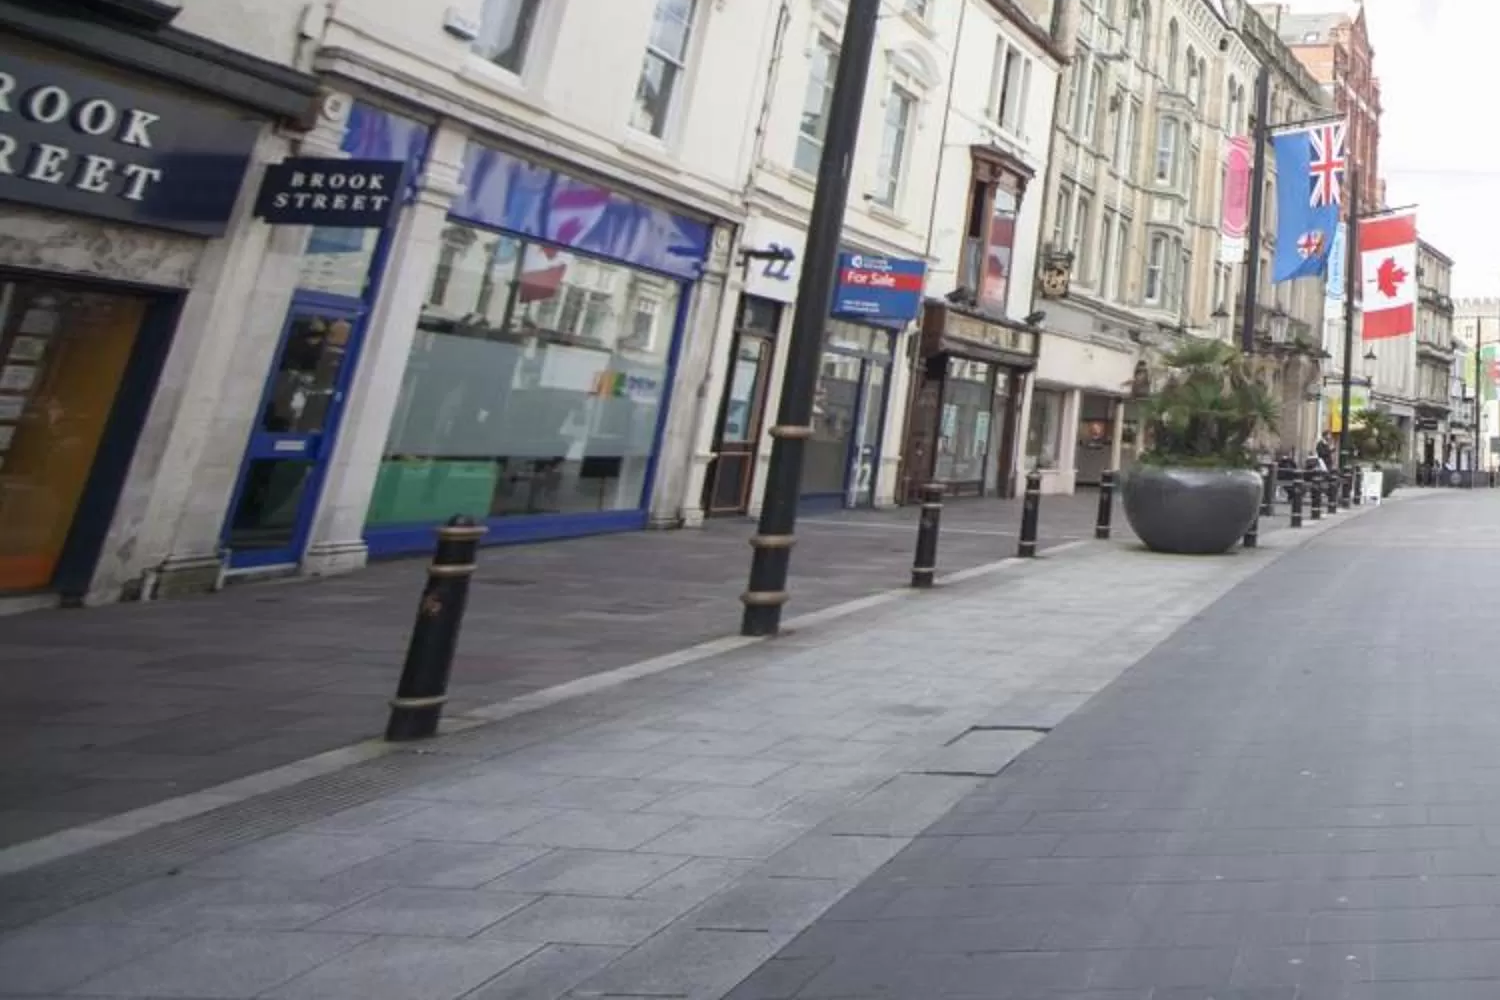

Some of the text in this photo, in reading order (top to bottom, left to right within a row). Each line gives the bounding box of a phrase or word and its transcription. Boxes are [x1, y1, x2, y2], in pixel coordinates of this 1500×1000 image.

[290, 171, 386, 189] BROOK
[272, 193, 390, 212] STREET
[847, 271, 897, 288] For Sale
